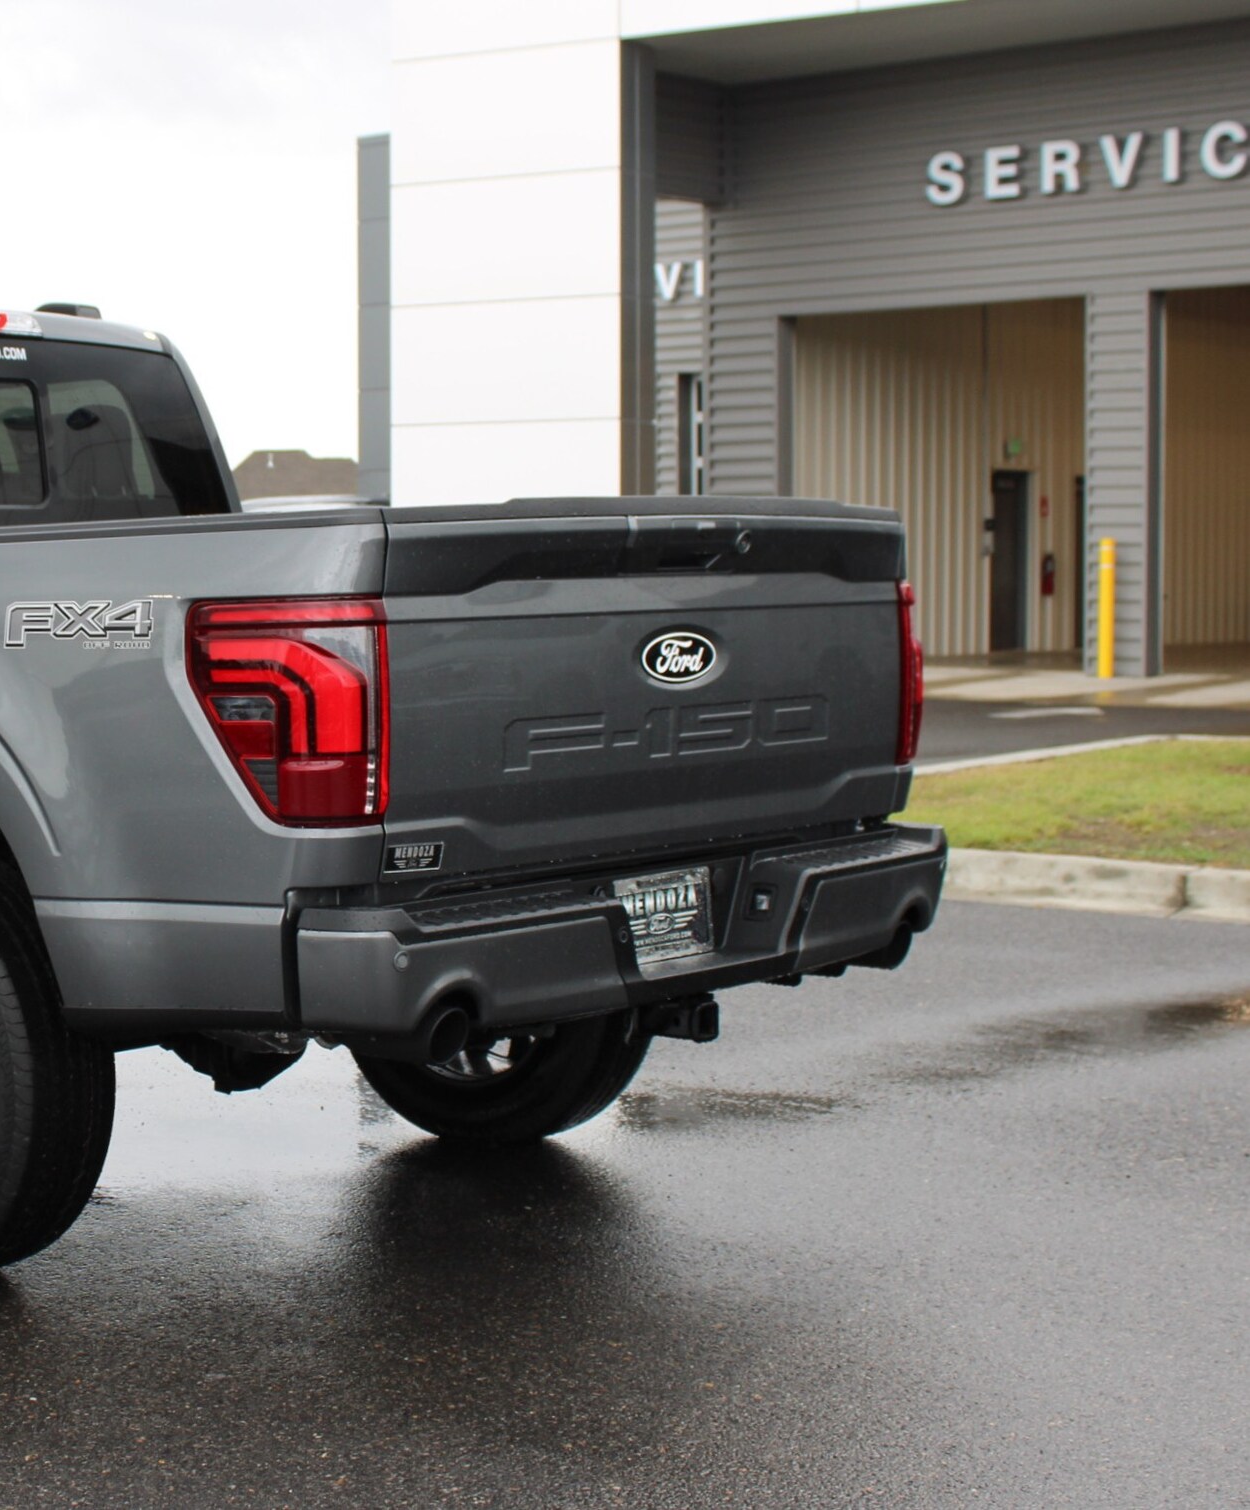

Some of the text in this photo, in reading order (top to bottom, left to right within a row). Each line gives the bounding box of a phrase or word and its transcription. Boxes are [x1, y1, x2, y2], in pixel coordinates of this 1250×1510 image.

[3, 599, 154, 649] FX4
[655, 638, 705, 673] Ford
[503, 693, 828, 772] F-150
[393, 845, 435, 859] MENDOZA
[622, 884, 697, 917] MENDOZA
